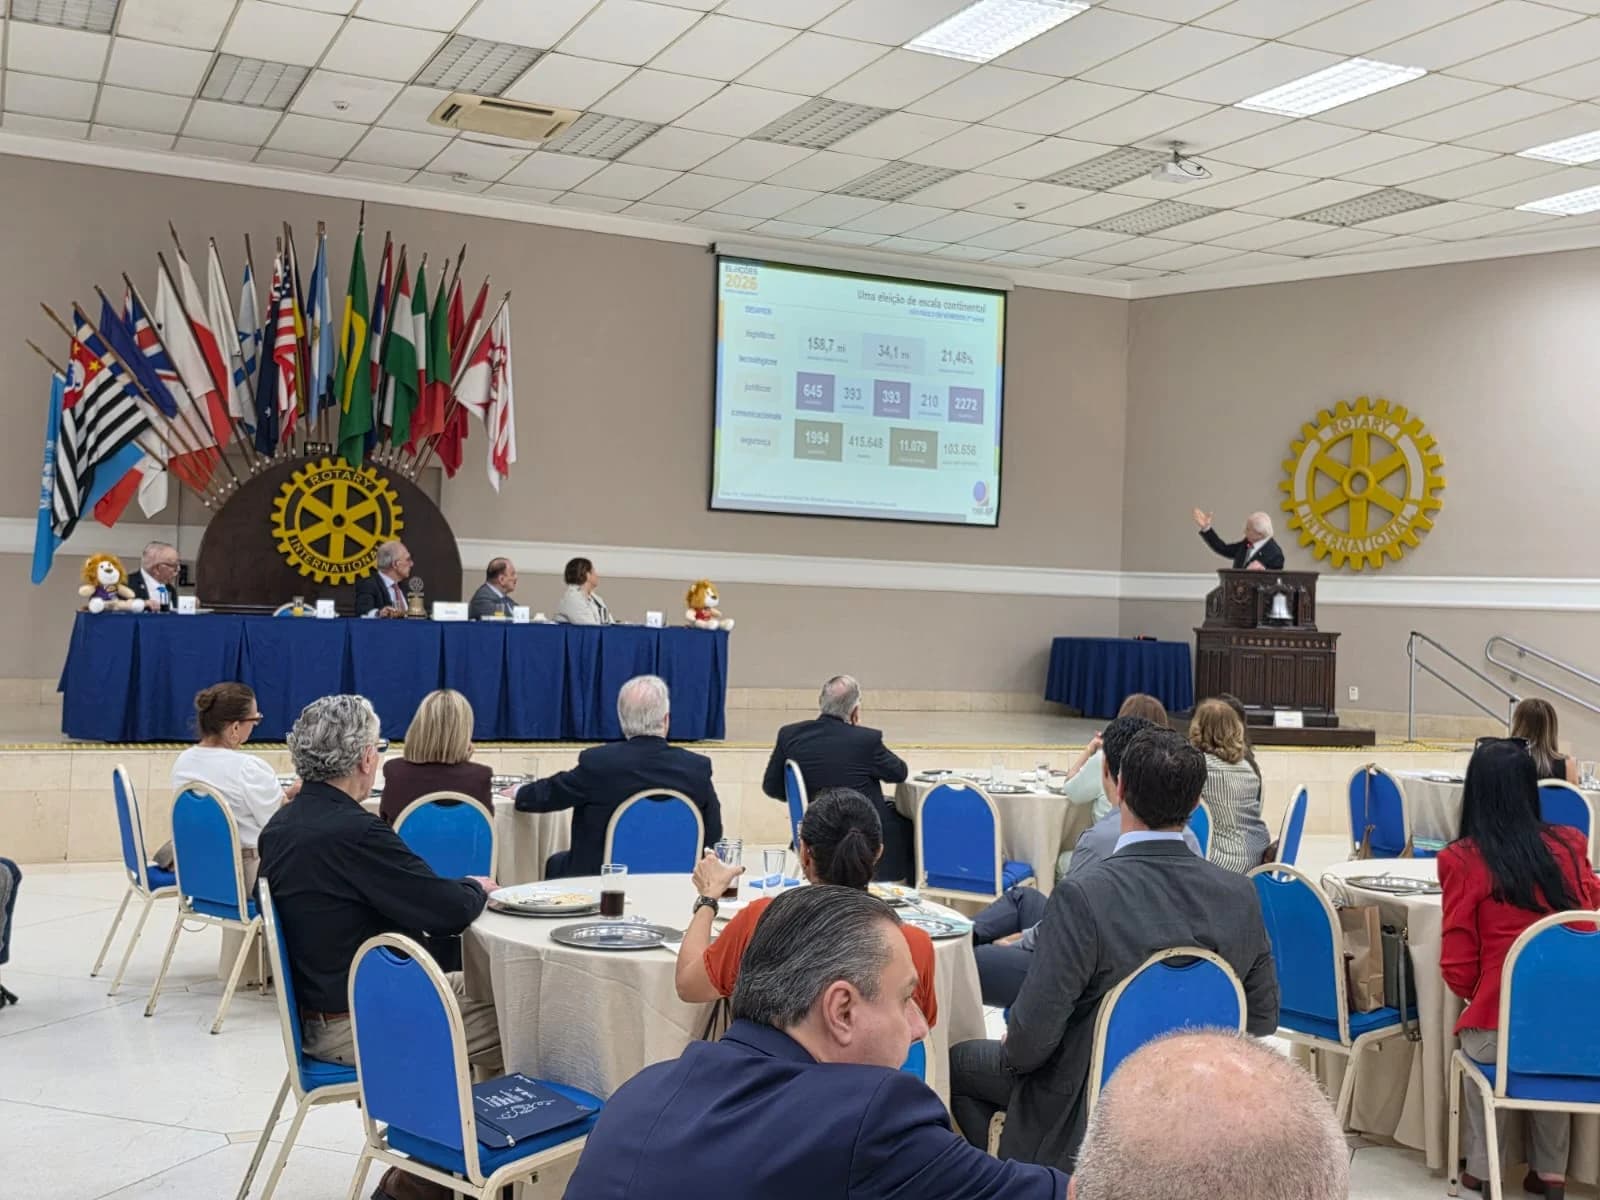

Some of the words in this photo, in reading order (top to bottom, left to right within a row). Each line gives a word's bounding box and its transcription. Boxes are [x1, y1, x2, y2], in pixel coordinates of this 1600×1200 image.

[857, 290, 875, 303] Uma
[878, 293, 904, 305] eleição
[907, 296, 916, 305] de
[918, 297, 941, 309] escala
[943, 301, 986, 313] continental
[807, 337, 835, 353] 158,7
[877, 344, 898, 359] 34,1
[802, 384, 823, 398] 645
[843, 387, 862, 401] 393
[882, 389, 901, 404] 393
[920, 393, 939, 408] 210
[954, 397, 978, 411] 2272
[1331, 414, 1391, 433] ROTARY
[310, 470, 372, 488] ROTARY
[1302, 514, 1413, 552] INTERNATIONAL
[291, 539, 378, 573] INTERNATIONA
